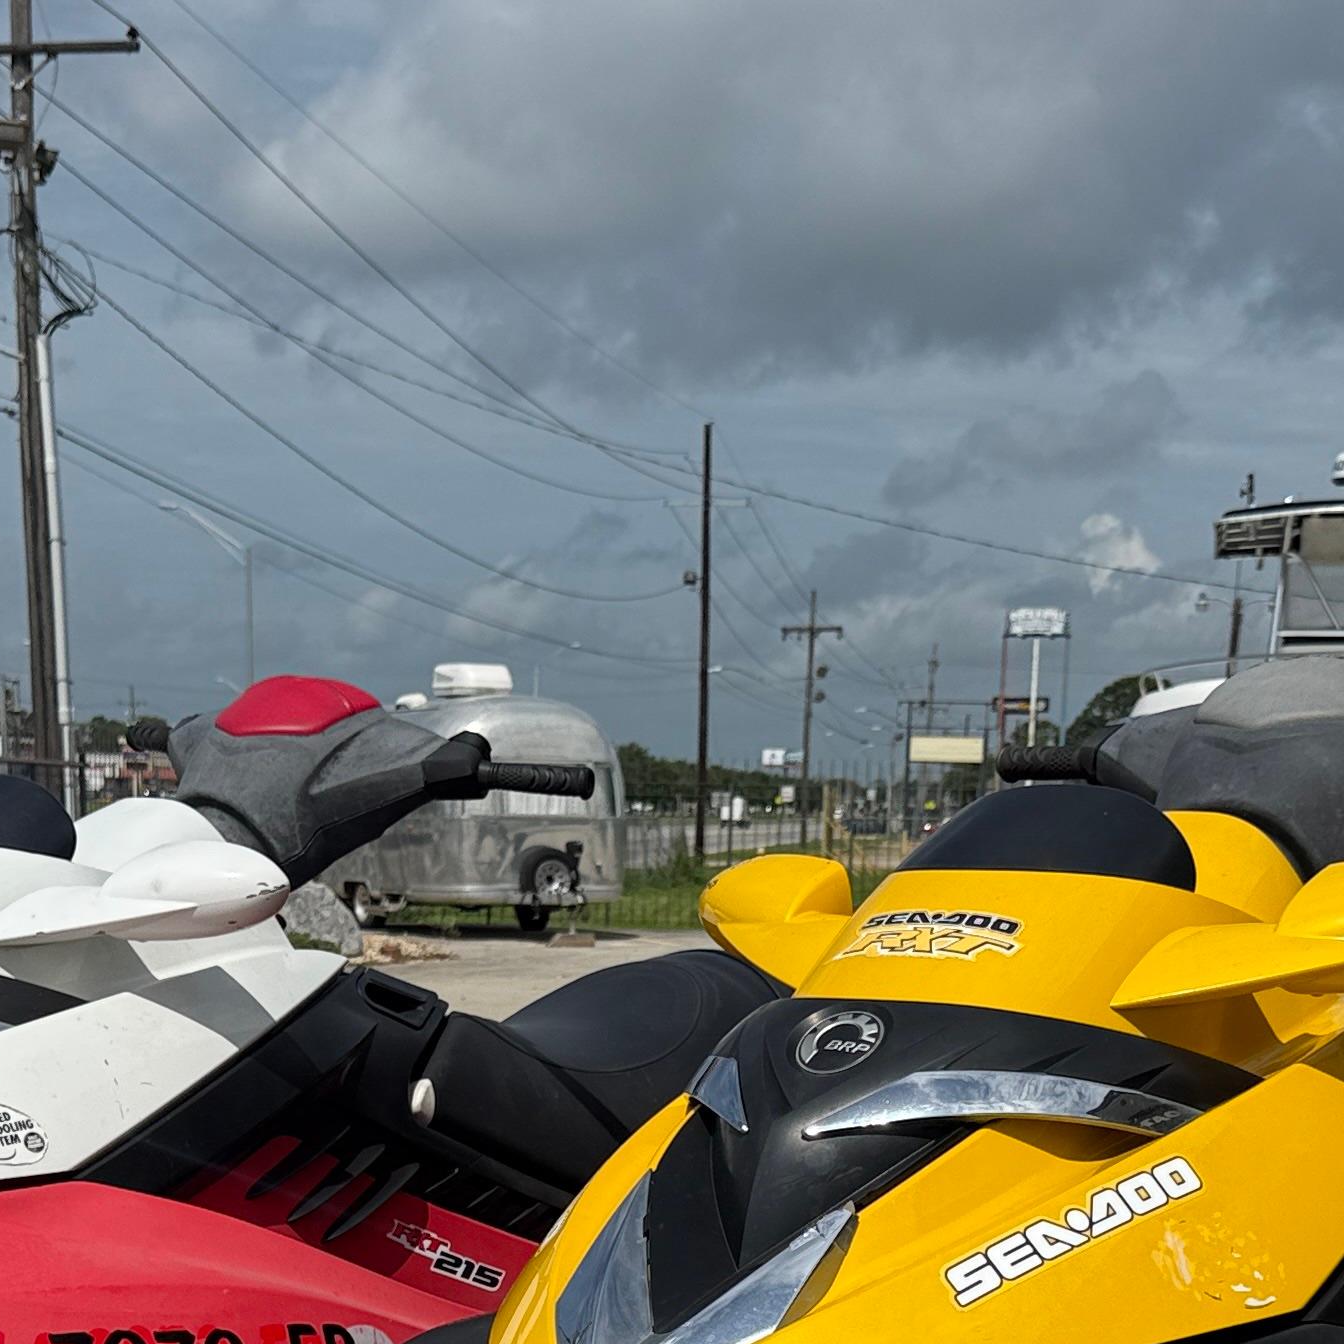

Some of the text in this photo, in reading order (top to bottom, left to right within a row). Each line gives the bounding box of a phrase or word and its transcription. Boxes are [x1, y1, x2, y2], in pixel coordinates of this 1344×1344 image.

[842, 926, 1016, 955] RXT
[823, 1039, 871, 1054] BRP
[432, 1251, 503, 1288] 215
